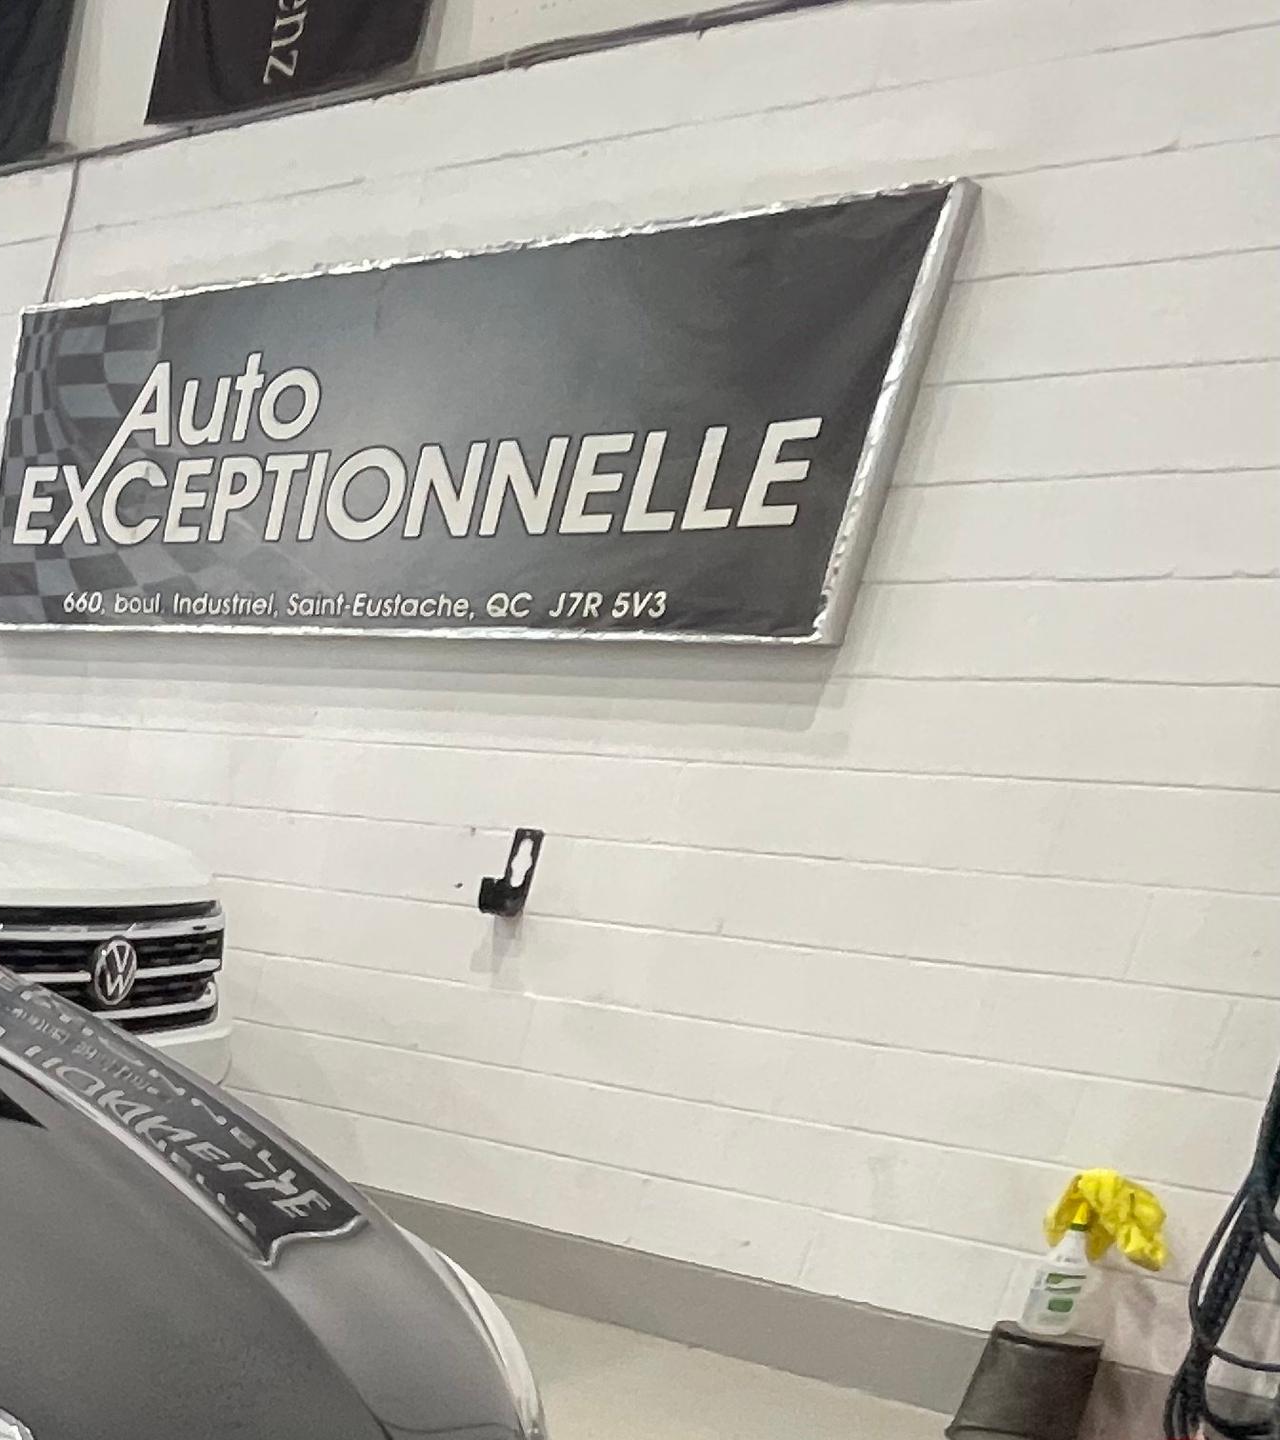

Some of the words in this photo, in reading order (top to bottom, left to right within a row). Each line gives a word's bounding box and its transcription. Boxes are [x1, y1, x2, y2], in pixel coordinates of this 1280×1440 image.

[100, 350, 322, 452] Auto
[10, 415, 824, 548] EXCEPTIONNELLE
[62, 591, 106, 616] 660,
[172, 592, 279, 618] Industriel,
[286, 592, 476, 621] Saint-Eustache,
[485, 592, 533, 619] QC
[548, 591, 604, 619] J7R
[611, 590, 668, 619] 5V3
